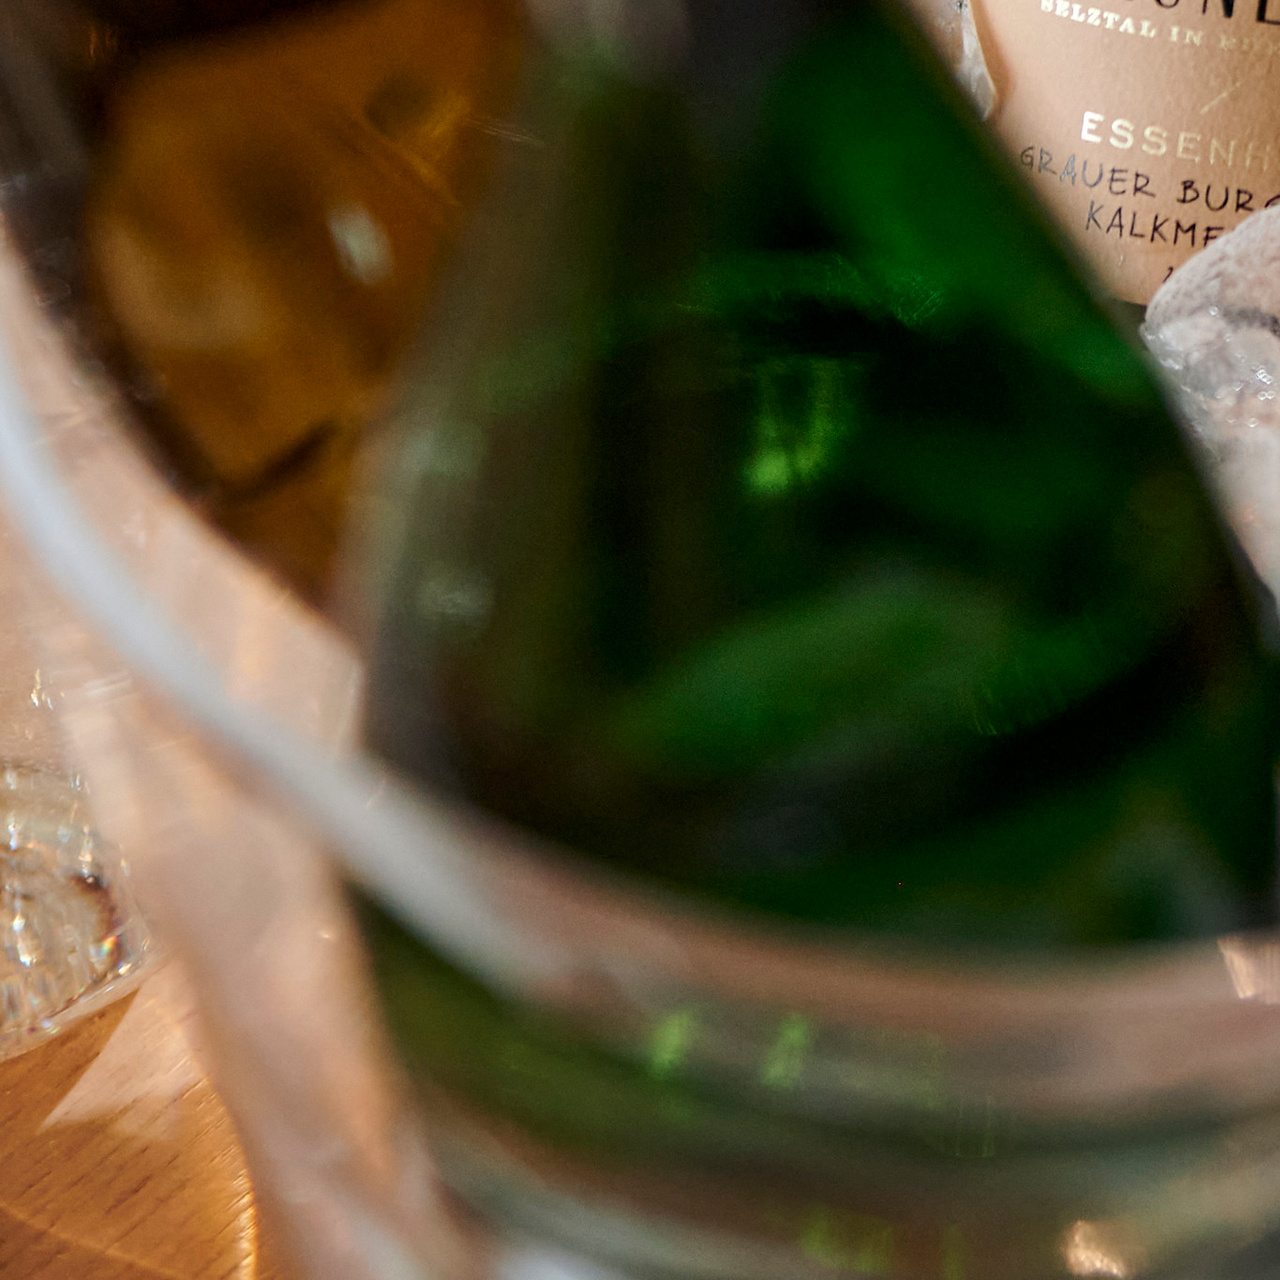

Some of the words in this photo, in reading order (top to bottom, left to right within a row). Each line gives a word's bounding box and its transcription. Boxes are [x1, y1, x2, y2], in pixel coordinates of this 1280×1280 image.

[1169, 25, 1204, 47] IN
[1019, 145, 1156, 198] GRAUER
[1085, 200, 1225, 249] KALKME
